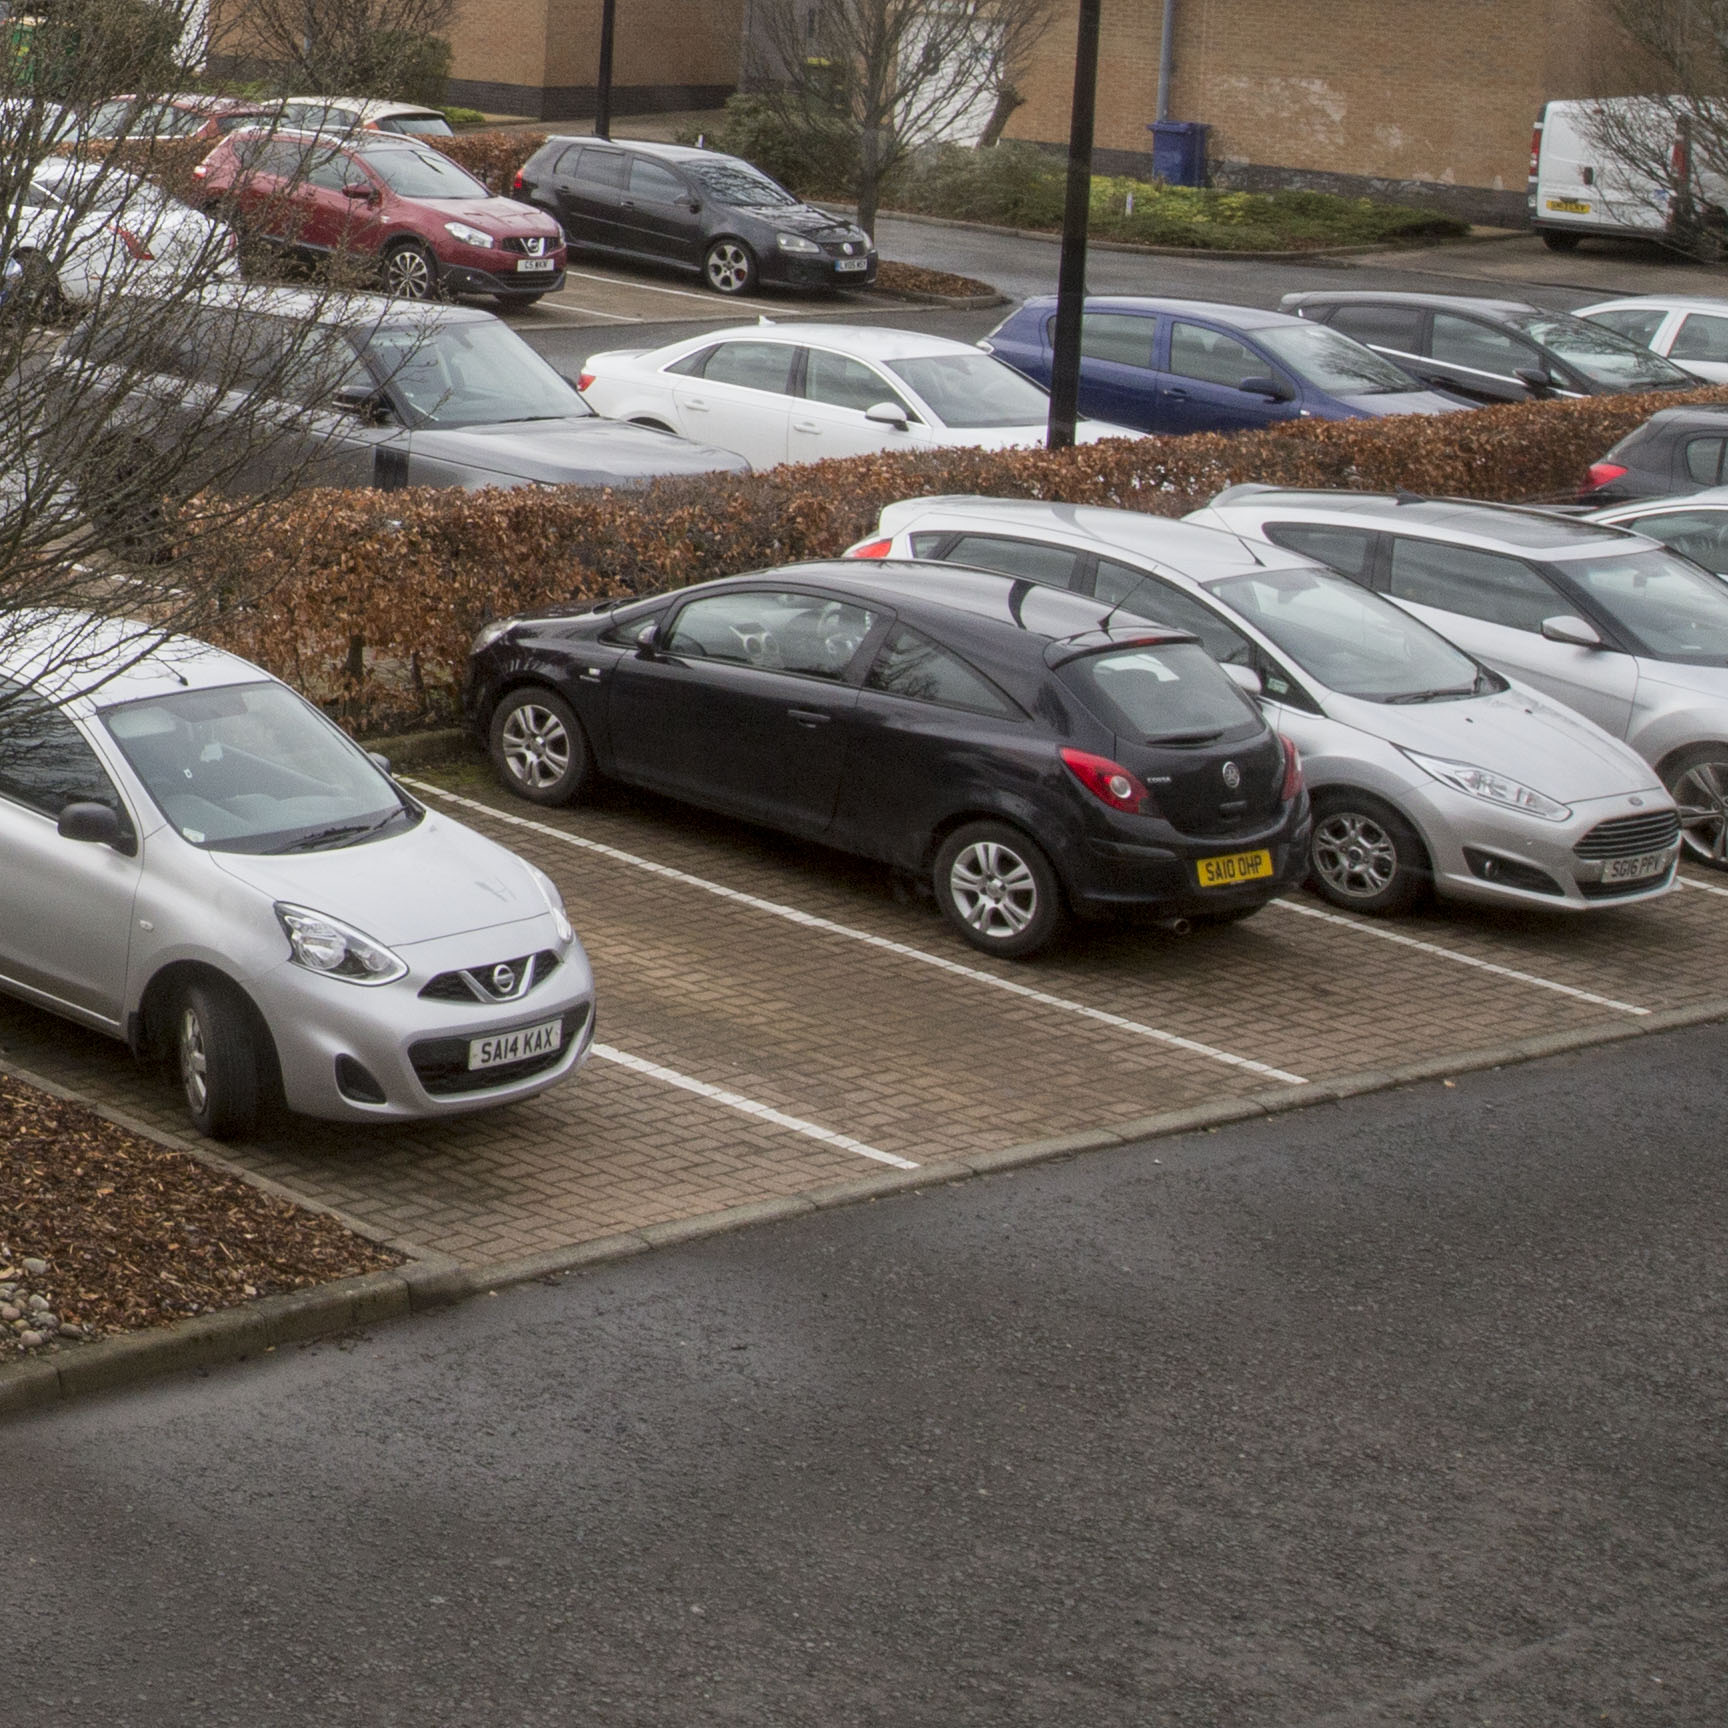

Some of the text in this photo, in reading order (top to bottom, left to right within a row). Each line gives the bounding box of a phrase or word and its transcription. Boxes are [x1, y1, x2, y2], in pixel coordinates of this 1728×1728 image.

[1205, 854, 1263, 882] SA10 OHP
[480, 1026, 554, 1064] SA14 KAX
